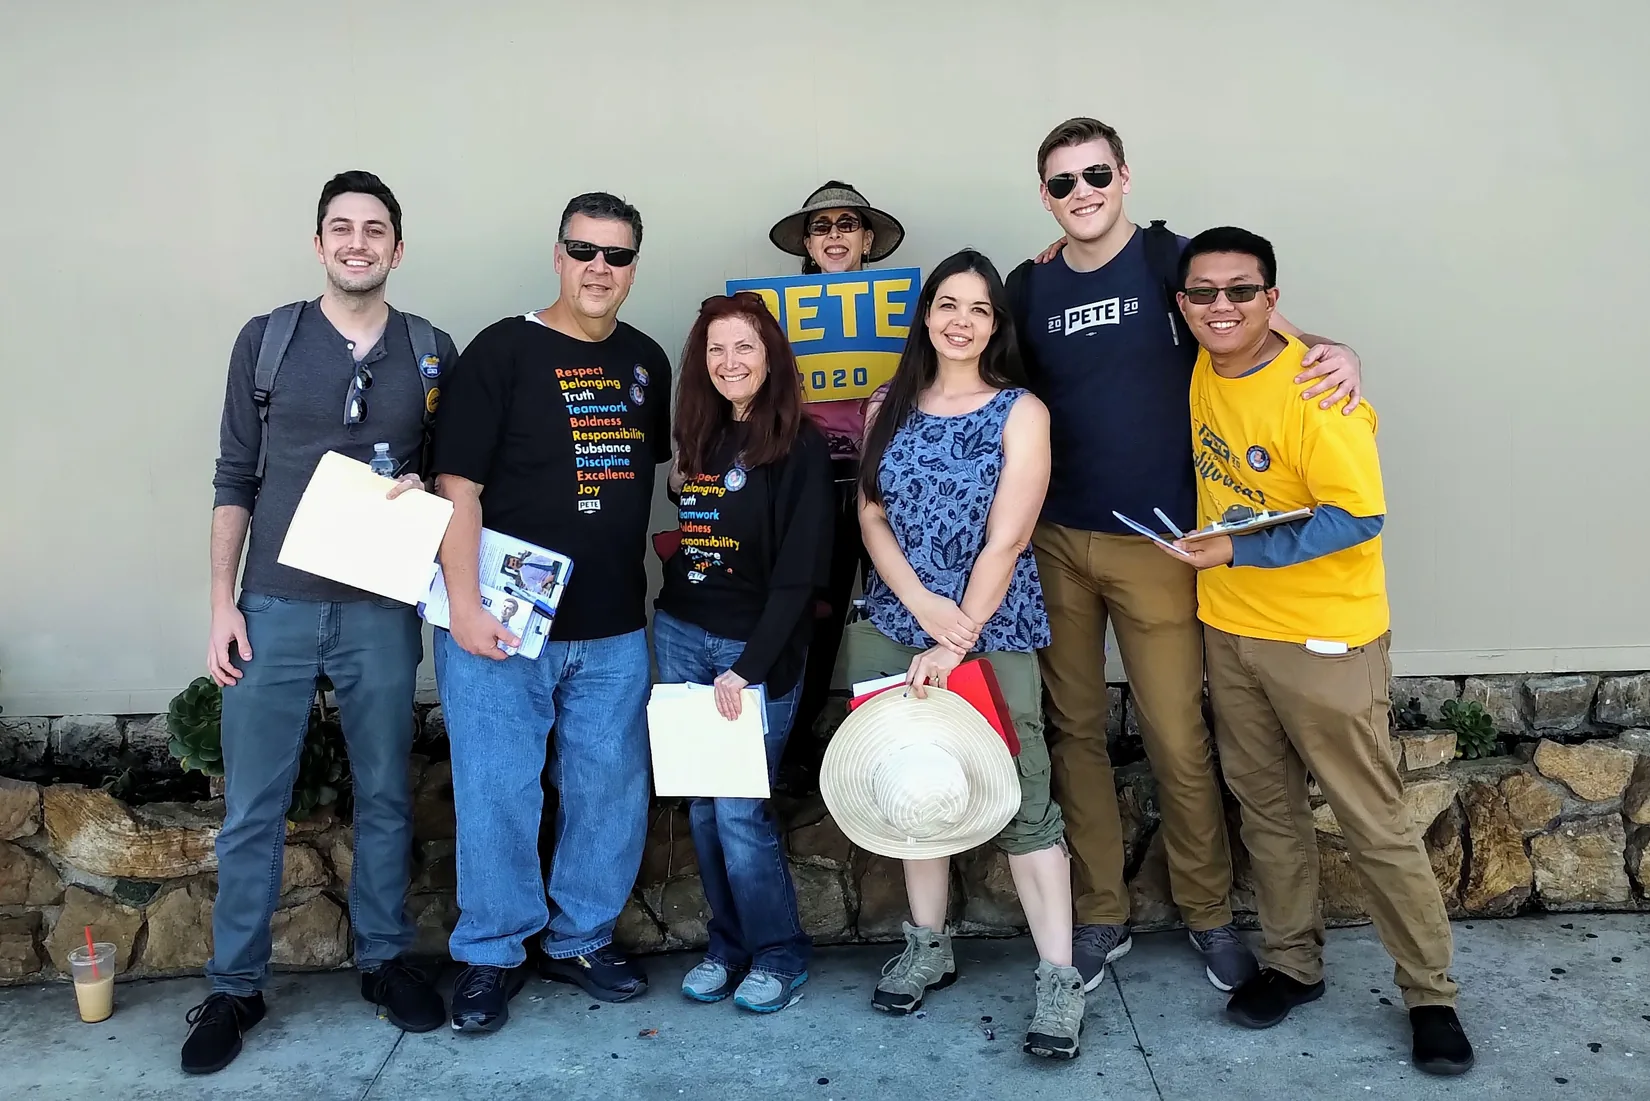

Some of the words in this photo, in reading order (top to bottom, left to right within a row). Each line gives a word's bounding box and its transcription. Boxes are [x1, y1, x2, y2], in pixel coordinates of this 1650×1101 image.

[1047, 318, 1061, 330] 20
[1068, 302, 1116, 329] PETE
[1123, 301, 1139, 312] 20
[555, 366, 603, 379] Respect
[559, 377, 621, 390] Belonging
[562, 389, 595, 402] Truth
[566, 401, 628, 415] Teamwork
[569, 415, 622, 428] Boldness
[572, 428, 645, 443] Responsibility
[574, 442, 632, 455] Substance
[576, 454, 631, 469] Discipline
[577, 468, 635, 481] Excellence
[577, 483, 601, 497] Joy
[579, 501, 600, 509] PETE
[680, 508, 720, 520] eamwork
